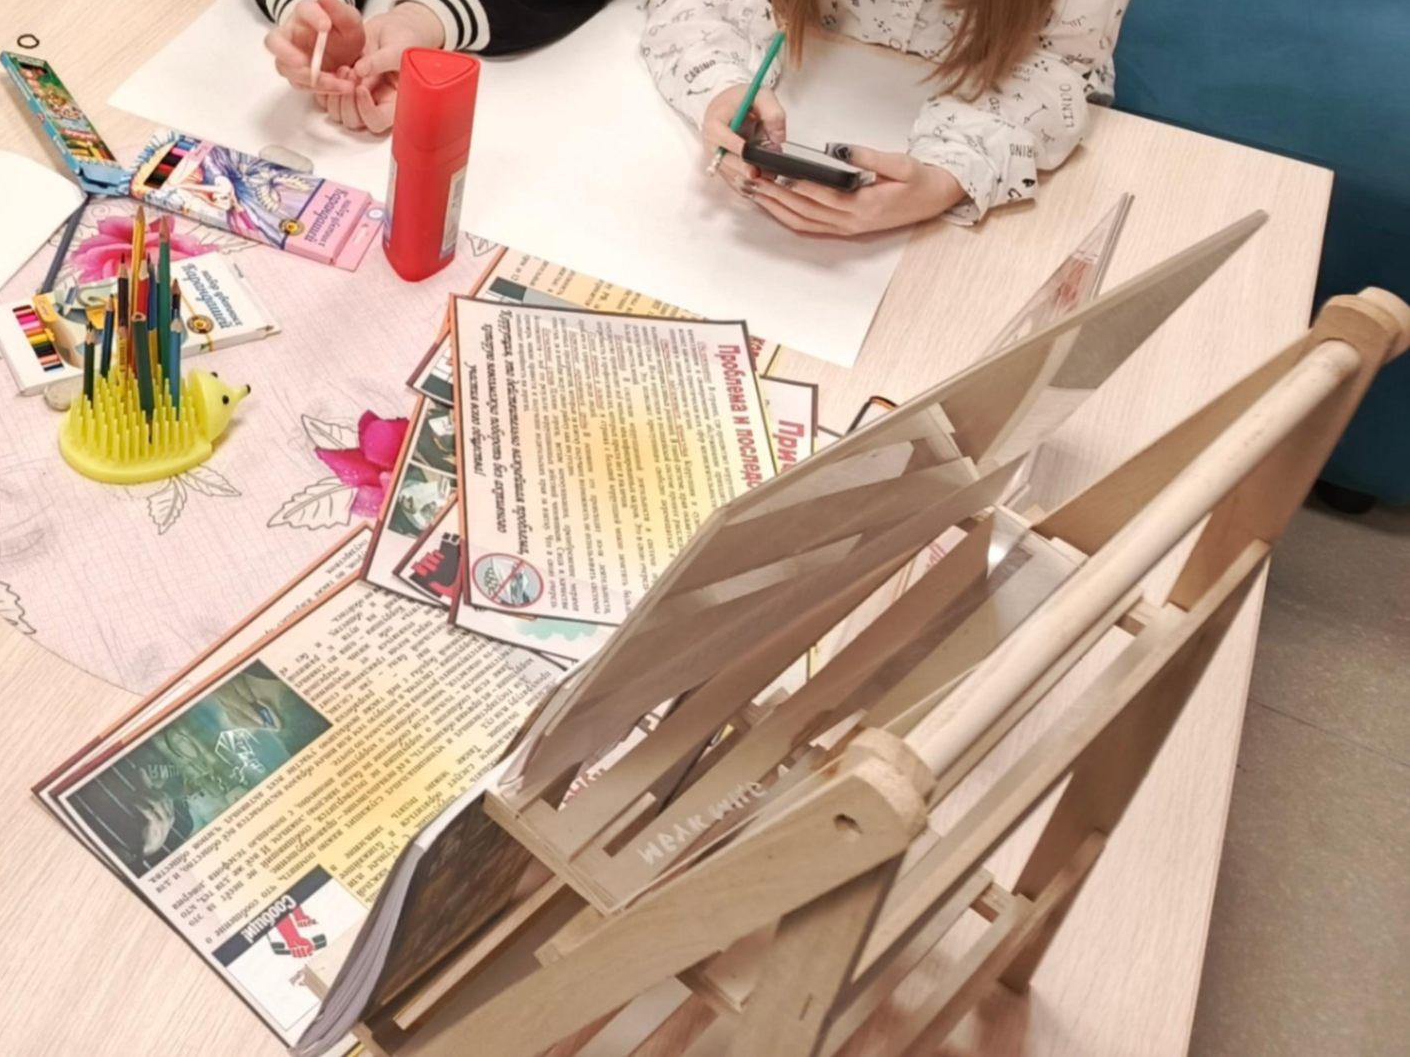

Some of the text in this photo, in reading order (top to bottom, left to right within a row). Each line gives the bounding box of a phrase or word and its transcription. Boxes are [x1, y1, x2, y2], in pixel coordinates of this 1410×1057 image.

[181, 263, 234, 330] Карандашей
[482, 322, 494, 360] которую
[484, 362, 497, 414] невозможно
[715, 344, 749, 414] Проблема
[465, 362, 485, 476] участия всего общества!
[502, 377, 522, 446] действительно
[731, 414, 750, 426] и
[486, 416, 504, 460] побороть
[509, 447, 527, 503] важнейшая
[492, 480, 506, 533] активного
[472, 678, 492, 694] если
[491, 661, 514, 680] Даже
[410, 714, 431, 731] если
[428, 694, 456, 716] только
[431, 693, 473, 728] сообщение
[451, 687, 513, 738] государственных
[369, 727, 414, 764] сообщение
[380, 732, 424, 768] коррупции
[339, 769, 364, 790] было
[382, 742, 446, 796] муниципальных
[303, 785, 341, 817] заведомо
[341, 793, 385, 829] служащих
[257, 822, 314, 870] сообщивший
[315, 828, 344, 852] важно
[218, 879, 246, 903] несёт
[211, 896, 262, 939] сообщение
[237, 890, 298, 944] Сообщи!
